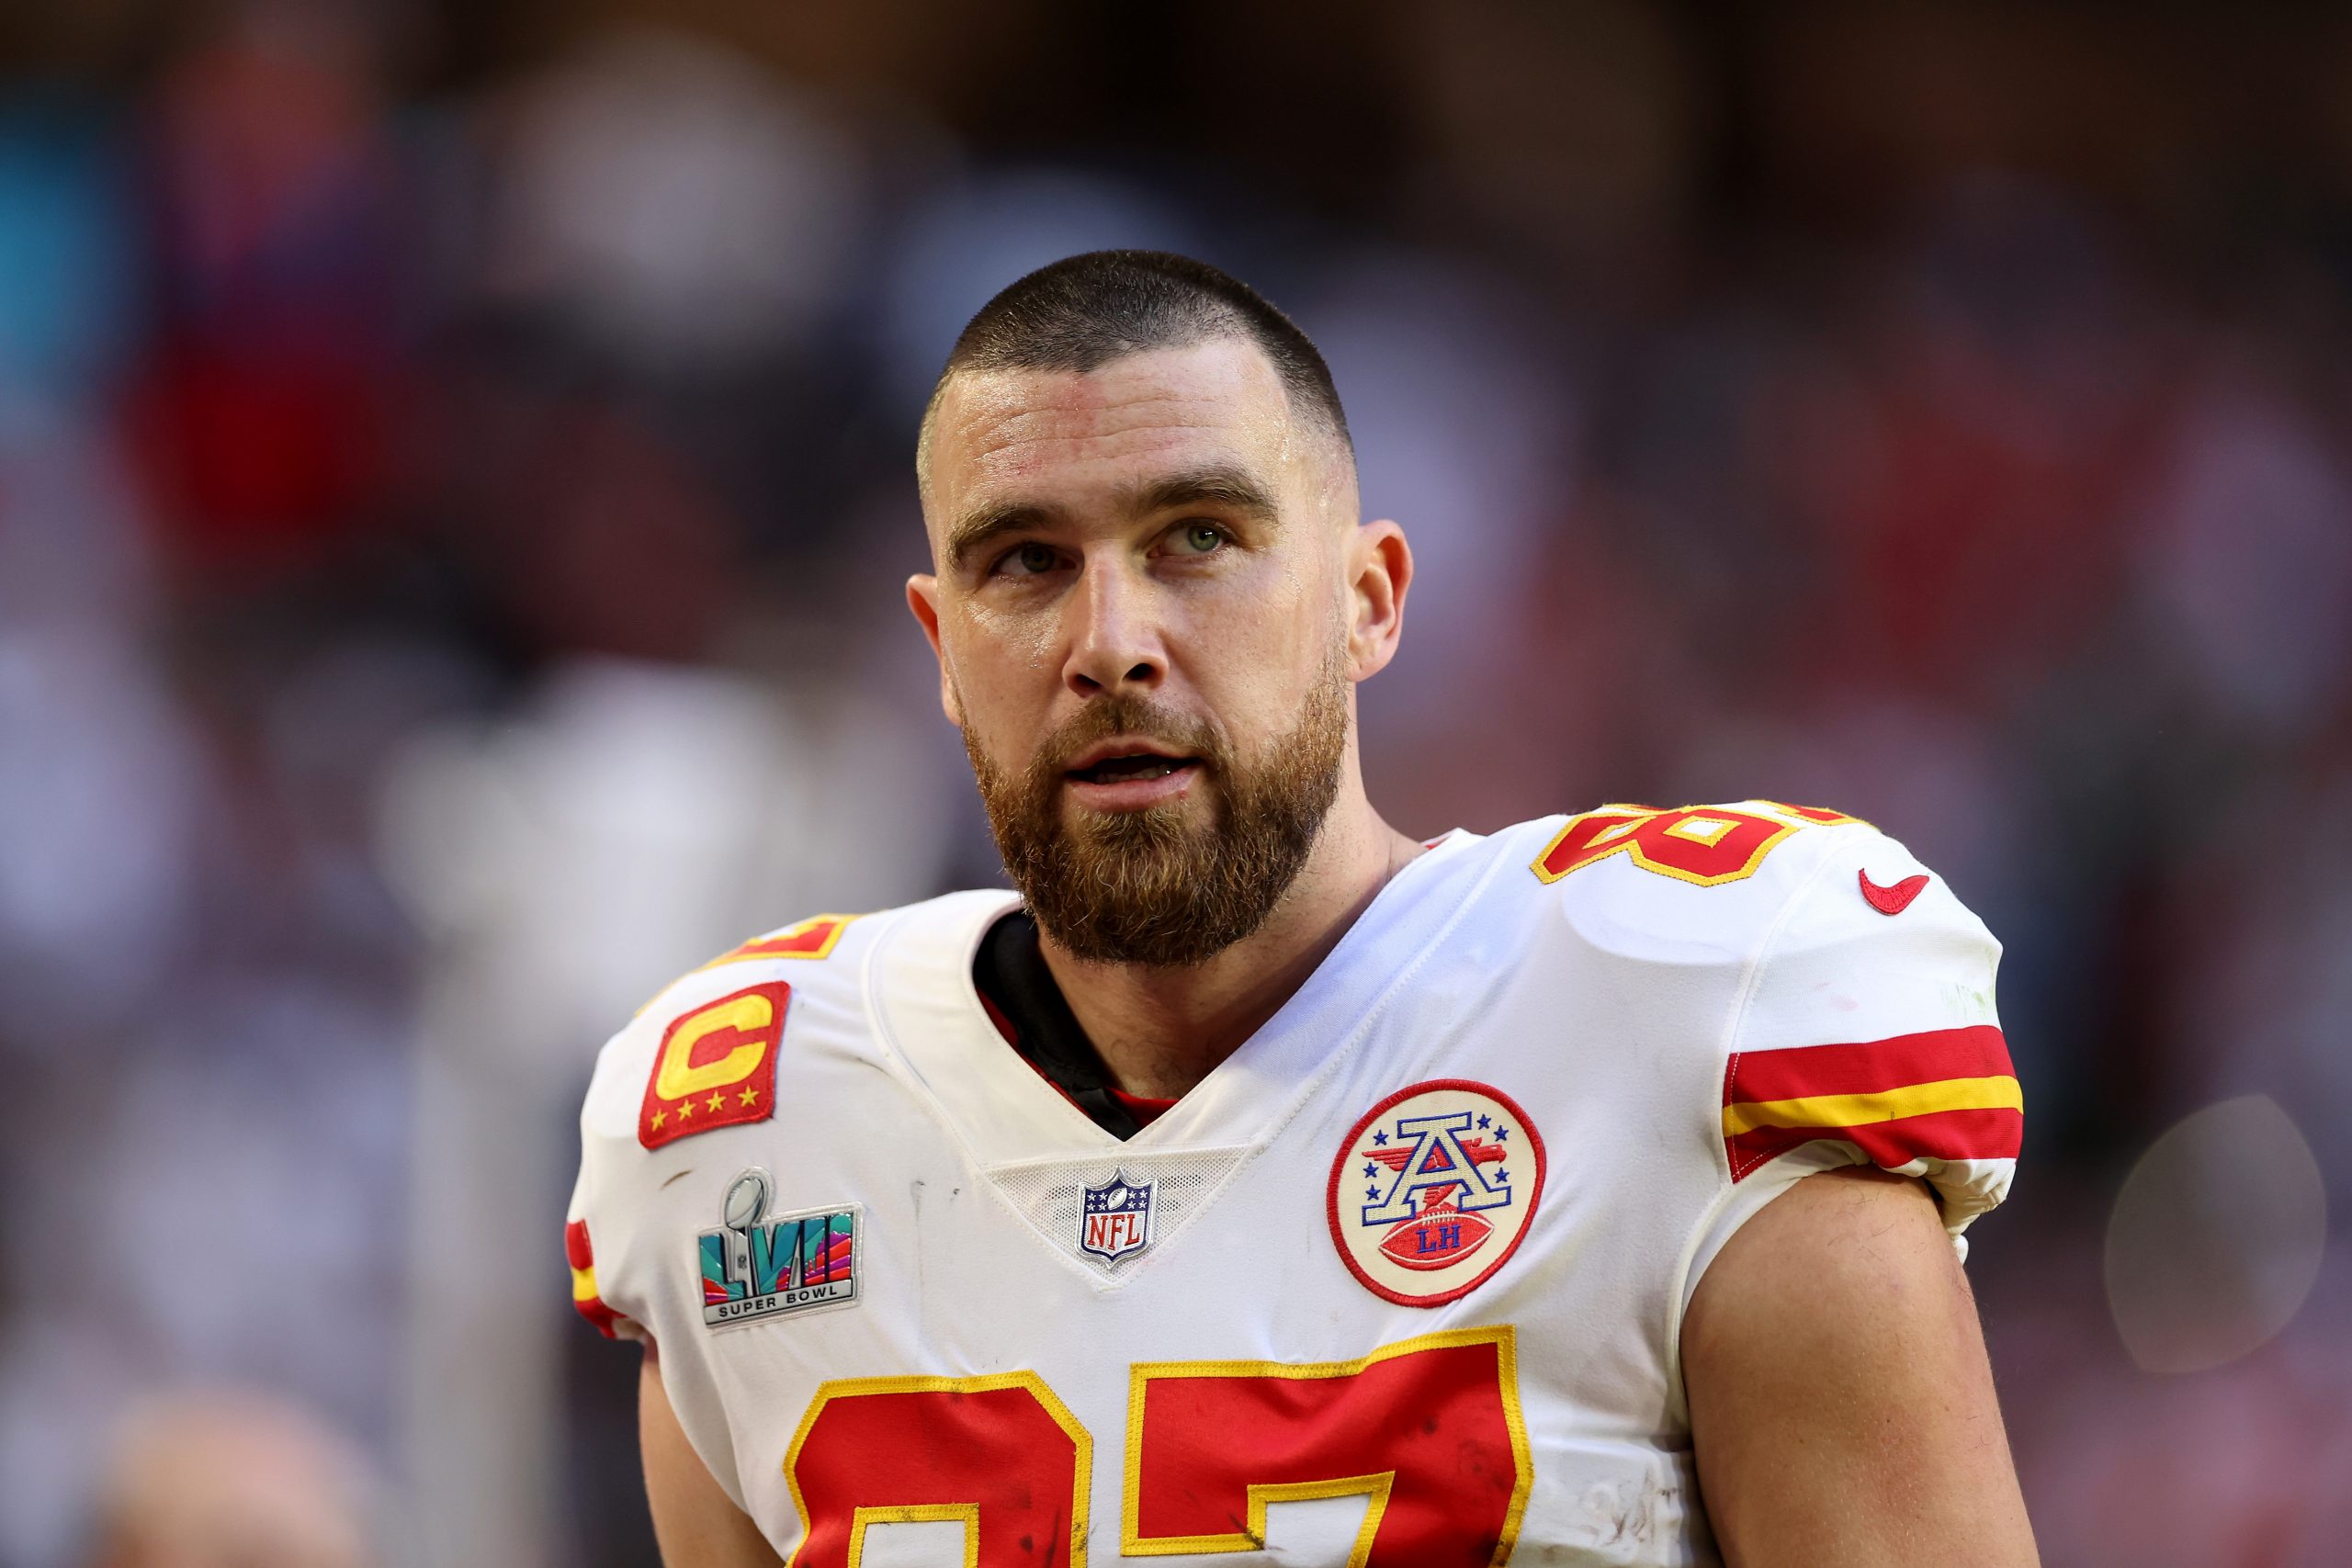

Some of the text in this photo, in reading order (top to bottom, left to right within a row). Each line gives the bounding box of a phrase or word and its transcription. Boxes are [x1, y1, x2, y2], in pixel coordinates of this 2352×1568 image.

[1529, 799, 1880, 887] 8
[655, 994, 774, 1101] C
[1362, 1111, 1512, 1227] A
[698, 1212, 854, 1306] LVII
[1087, 1213, 1140, 1251] NFL
[1416, 1224, 1461, 1254] LH
[718, 1285, 838, 1318] SUPER BOWL
